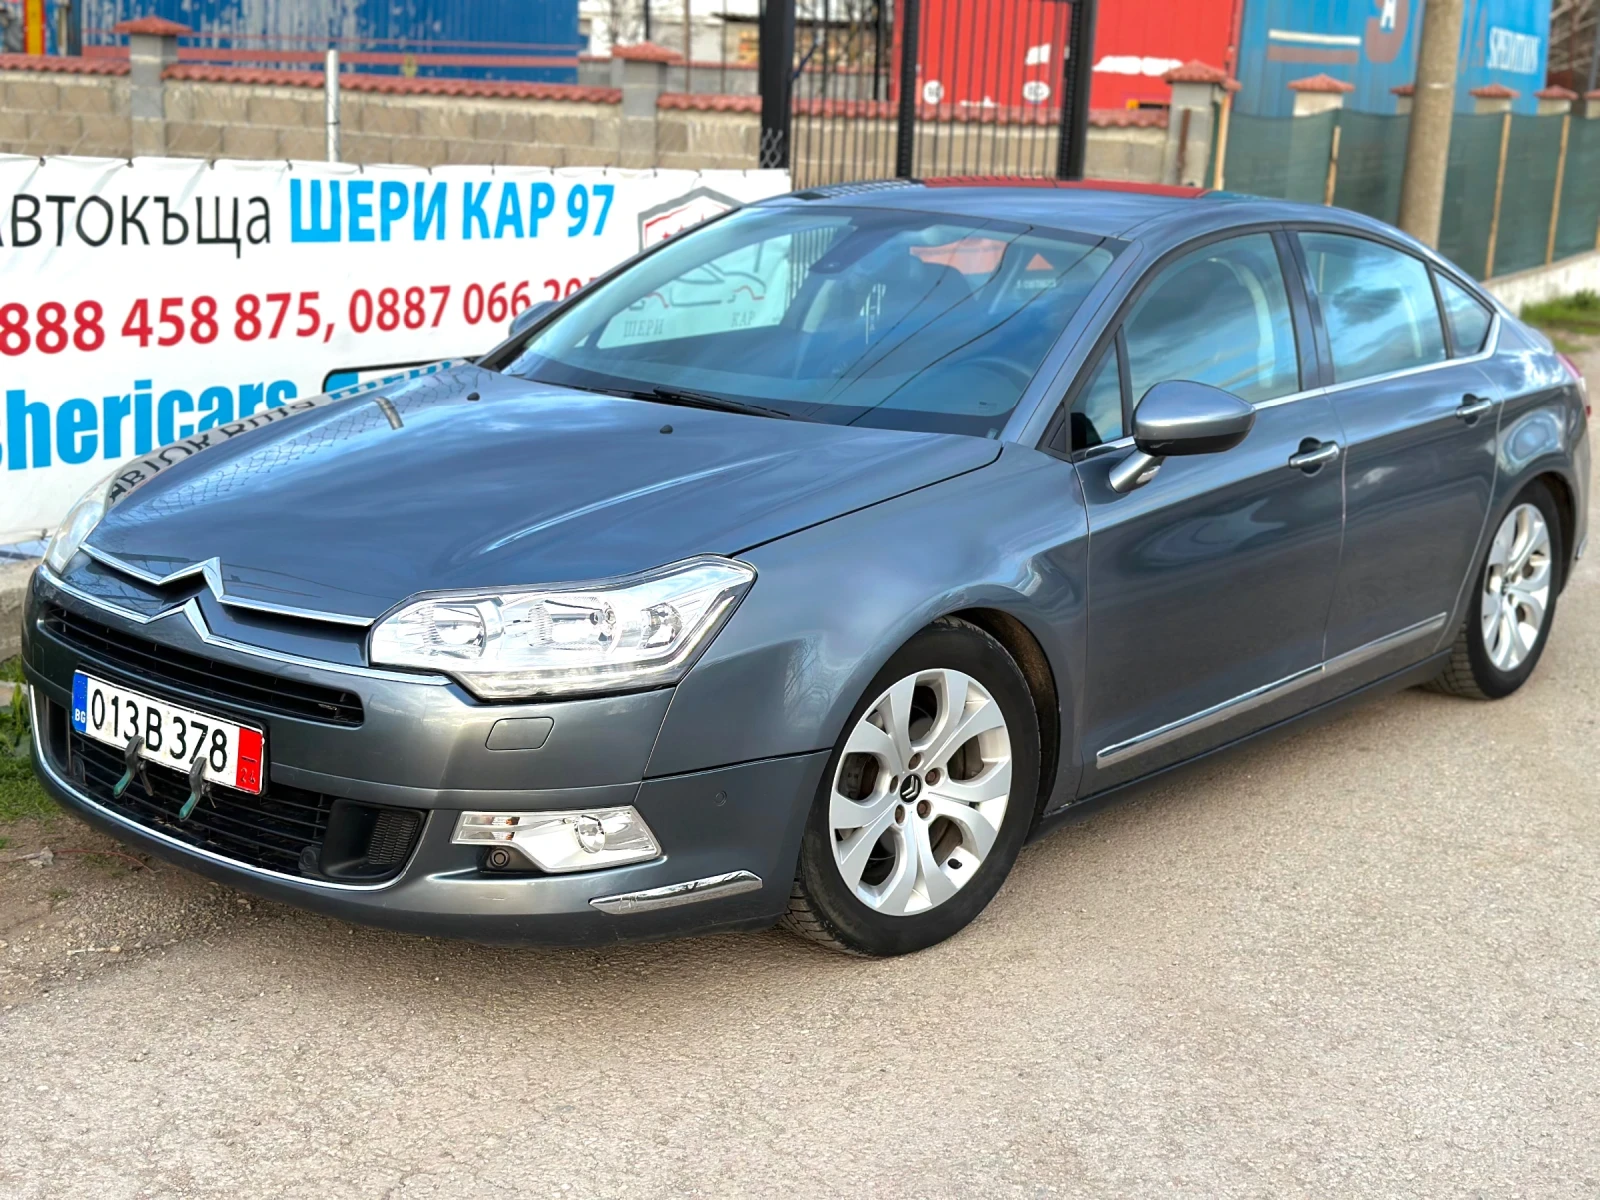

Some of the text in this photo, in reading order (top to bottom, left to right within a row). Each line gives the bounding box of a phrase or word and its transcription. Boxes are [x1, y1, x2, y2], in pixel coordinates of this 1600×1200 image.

[290, 179, 447, 242] ШЕРИ
[463, 182, 555, 239] КАР
[567, 184, 615, 238] 97
[121, 295, 219, 347] 458
[235, 291, 334, 342] 875,
[349, 285, 450, 333] 0887
[463, 279, 533, 326] 066
[623, 318, 665, 338] ШЕРИ
[731, 311, 756, 328] КАР
[0, 379, 298, 471] hericars
[74, 708, 86, 723] BG
[91, 688, 227, 773] 013B378
